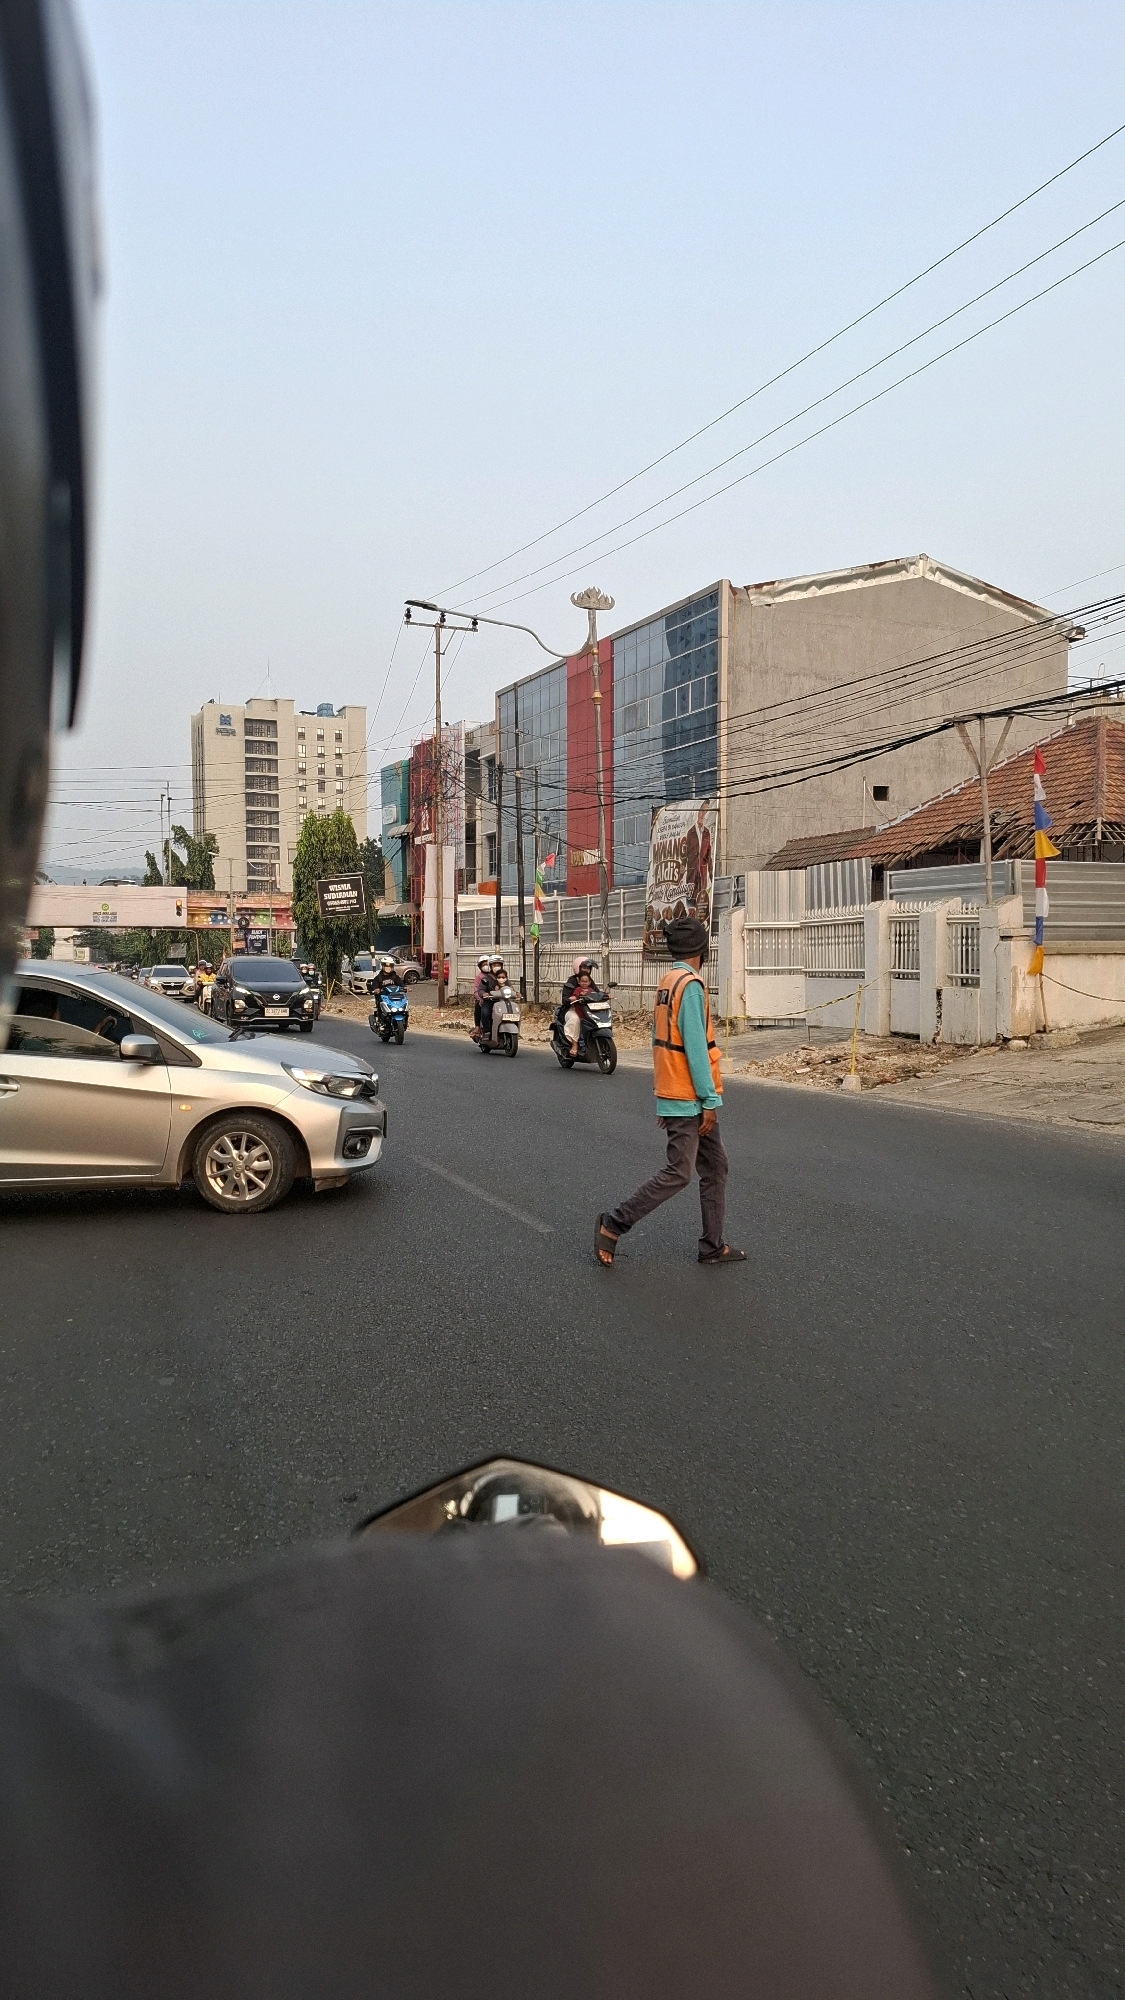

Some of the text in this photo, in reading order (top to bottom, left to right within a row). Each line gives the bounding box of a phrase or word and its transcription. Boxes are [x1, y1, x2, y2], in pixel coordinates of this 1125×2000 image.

[653, 836, 687, 865] MINANG
[656, 861, 679, 884] Aldi's
[323, 890, 358, 900] SUDIRMAN
[328, 883, 352, 892] WISMA
